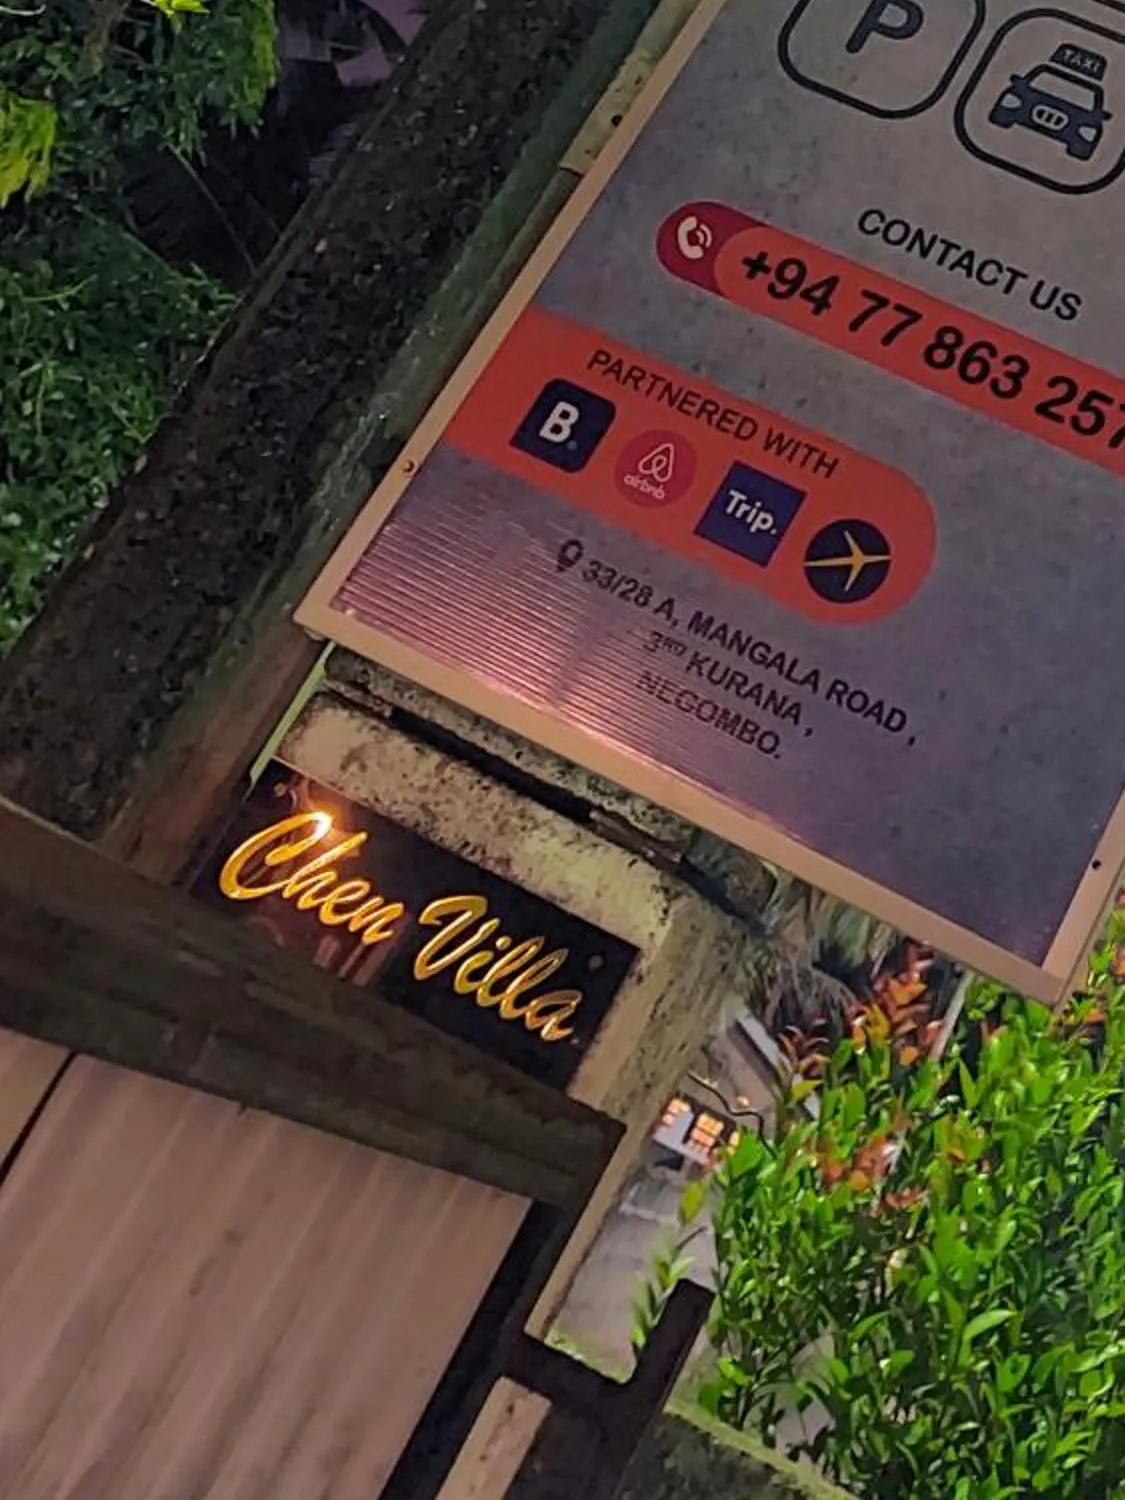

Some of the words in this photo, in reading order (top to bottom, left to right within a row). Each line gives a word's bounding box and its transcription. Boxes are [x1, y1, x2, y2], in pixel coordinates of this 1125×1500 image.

[1061, 46, 1102, 75] TAXI
[742, 251, 840, 316] +94
[847, 288, 923, 347] 77
[923, 325, 1031, 400] 863
[857, 208, 1029, 296] CONTACT
[1030, 279, 1084, 322] US
[587, 349, 759, 441] PARTNERED
[762, 428, 841, 479] WITH
[623, 473, 666, 500] airbnb
[582, 559, 652, 607] 33/28
[654, 597, 679, 628] A,
[687, 611, 821, 694] MANGALA
[636, 670, 782, 760] NEGOMBO.
[219, 811, 404, 945] Chen
[413, 895, 583, 1042] Villa
